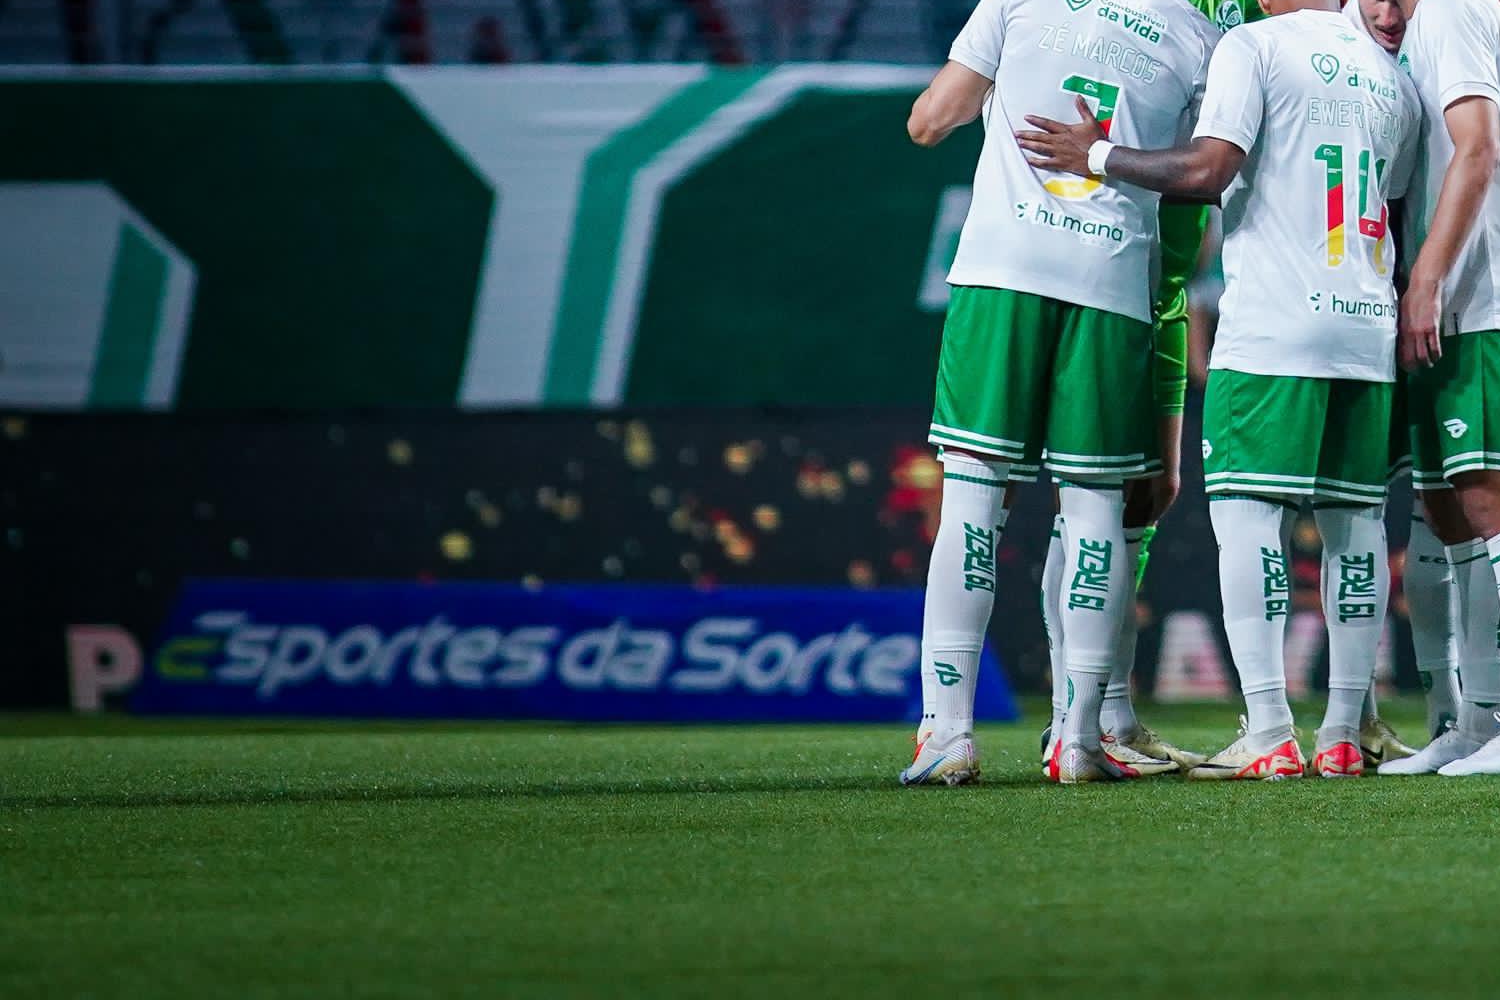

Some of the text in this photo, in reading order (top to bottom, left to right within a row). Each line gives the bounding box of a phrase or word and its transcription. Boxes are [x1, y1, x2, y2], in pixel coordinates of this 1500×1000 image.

[1097, 6, 1160, 43] da Vida
[1072, 34, 1161, 85] MARCOS
[1036, 204, 1123, 242] humana
[1314, 143, 1388, 274] 14
[555, 618, 672, 690] da
